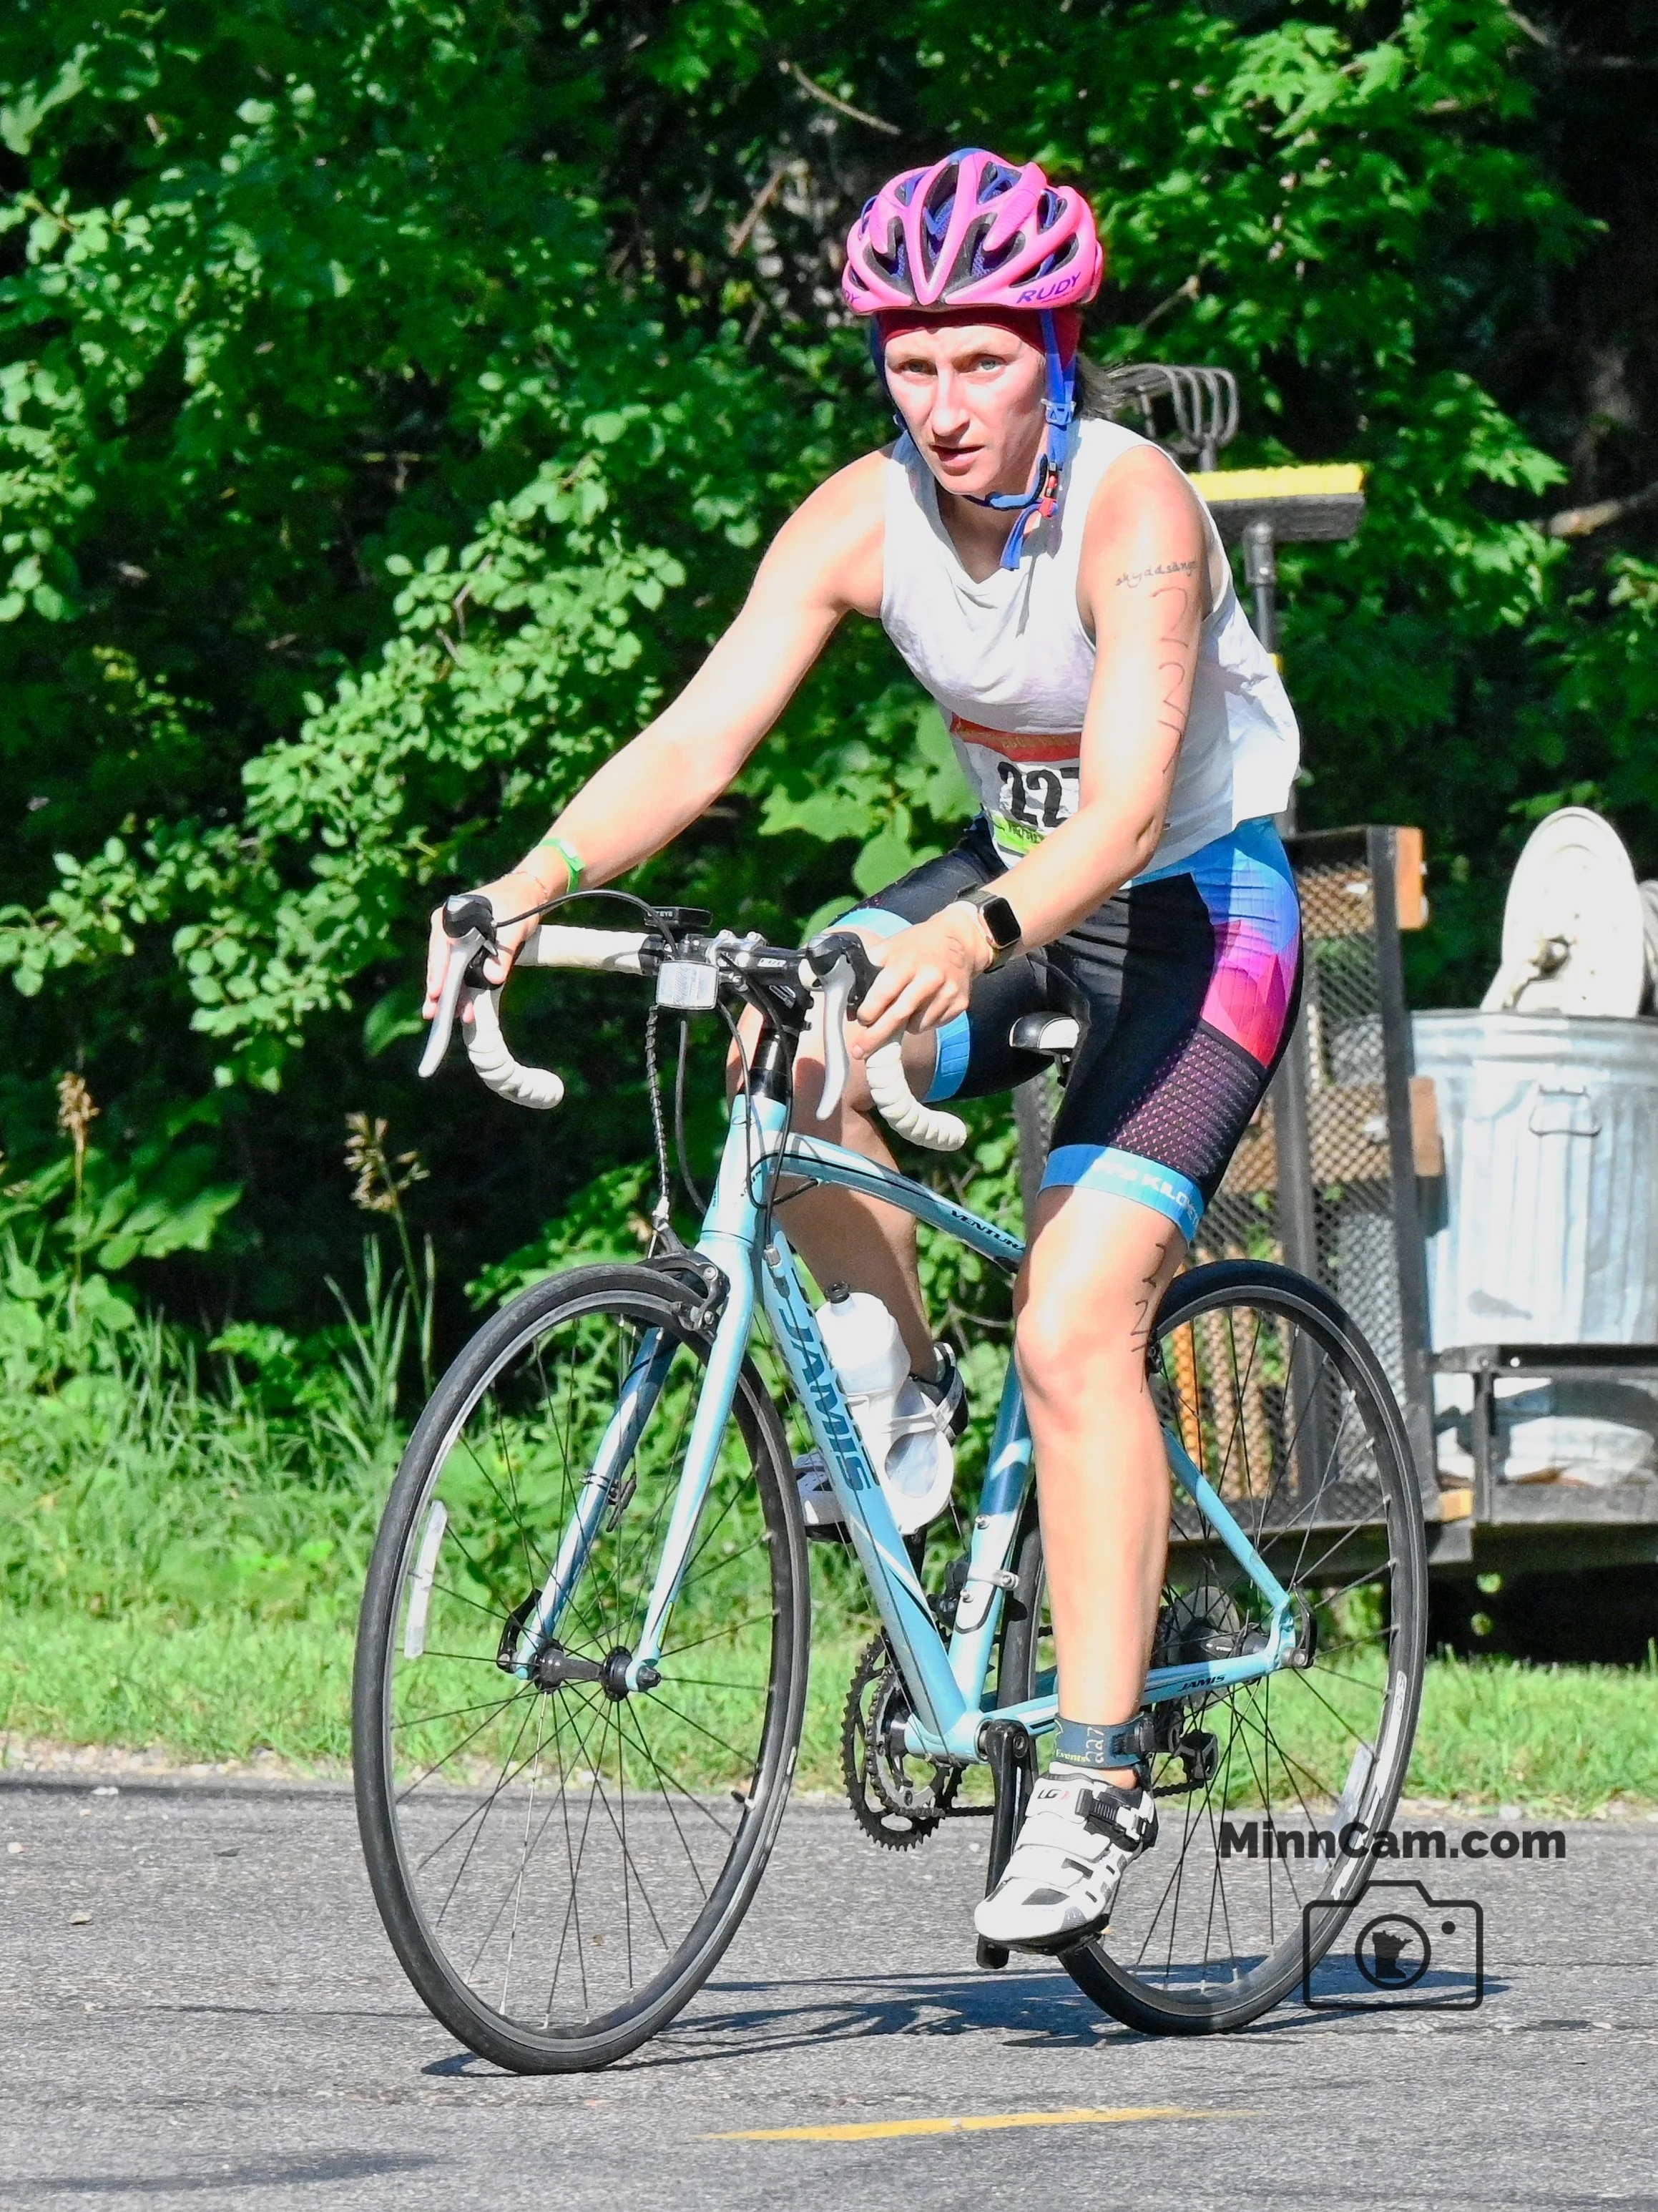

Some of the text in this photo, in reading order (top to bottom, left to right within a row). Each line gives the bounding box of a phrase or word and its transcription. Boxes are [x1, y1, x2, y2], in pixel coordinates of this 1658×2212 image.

[1016, 272, 1081, 304] RUDY
[997, 761, 1080, 827] 22
[778, 1308, 873, 1491] JAMIS
[1177, 1673, 1227, 1692] JAMIS
[1085, 1726, 1104, 1763] 227
